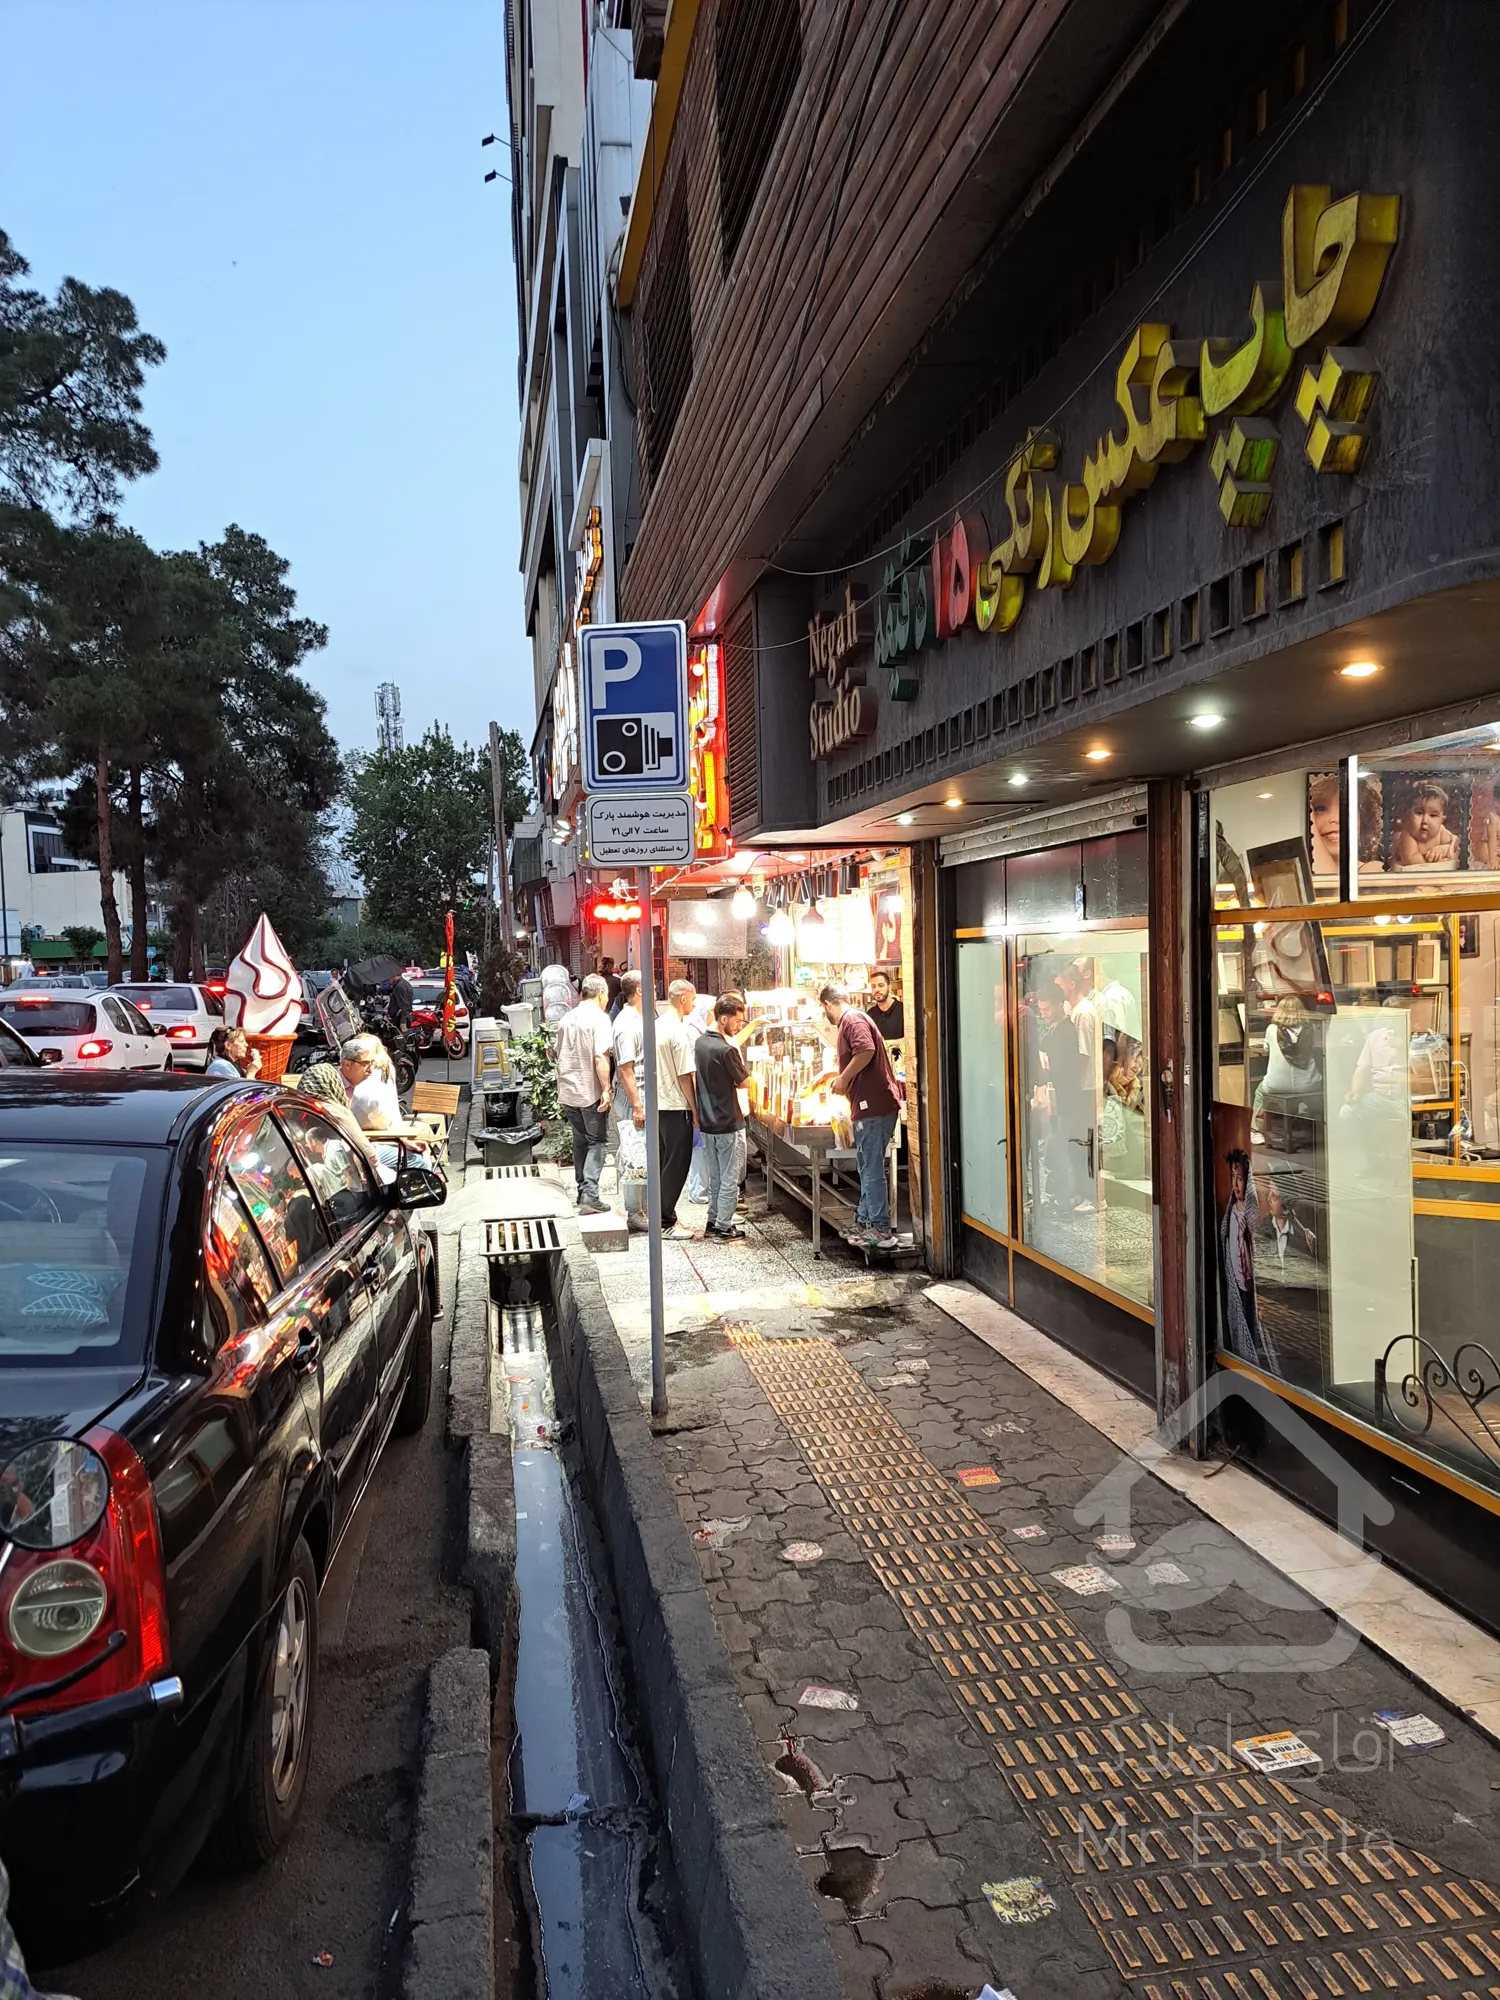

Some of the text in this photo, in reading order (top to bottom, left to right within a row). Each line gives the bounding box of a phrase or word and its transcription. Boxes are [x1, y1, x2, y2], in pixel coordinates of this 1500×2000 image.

[1201, 184, 1400, 527] چاپ
[1061, 323, 1205, 566] عکس
[976, 426, 1076, 633] رنگی
[808, 581, 858, 689] Negah
[590, 637, 642, 710] P
[809, 667, 864, 760] Studio
[593, 810, 687, 821] مدیریت هوشمند پارک
[599, 847, 621, 856] تعطیل
[611, 826, 669, 837] ساعت ۷ الی ۲۱
[622, 846, 648, 855] روزهای
[649, 845, 675, 854] استثنای
